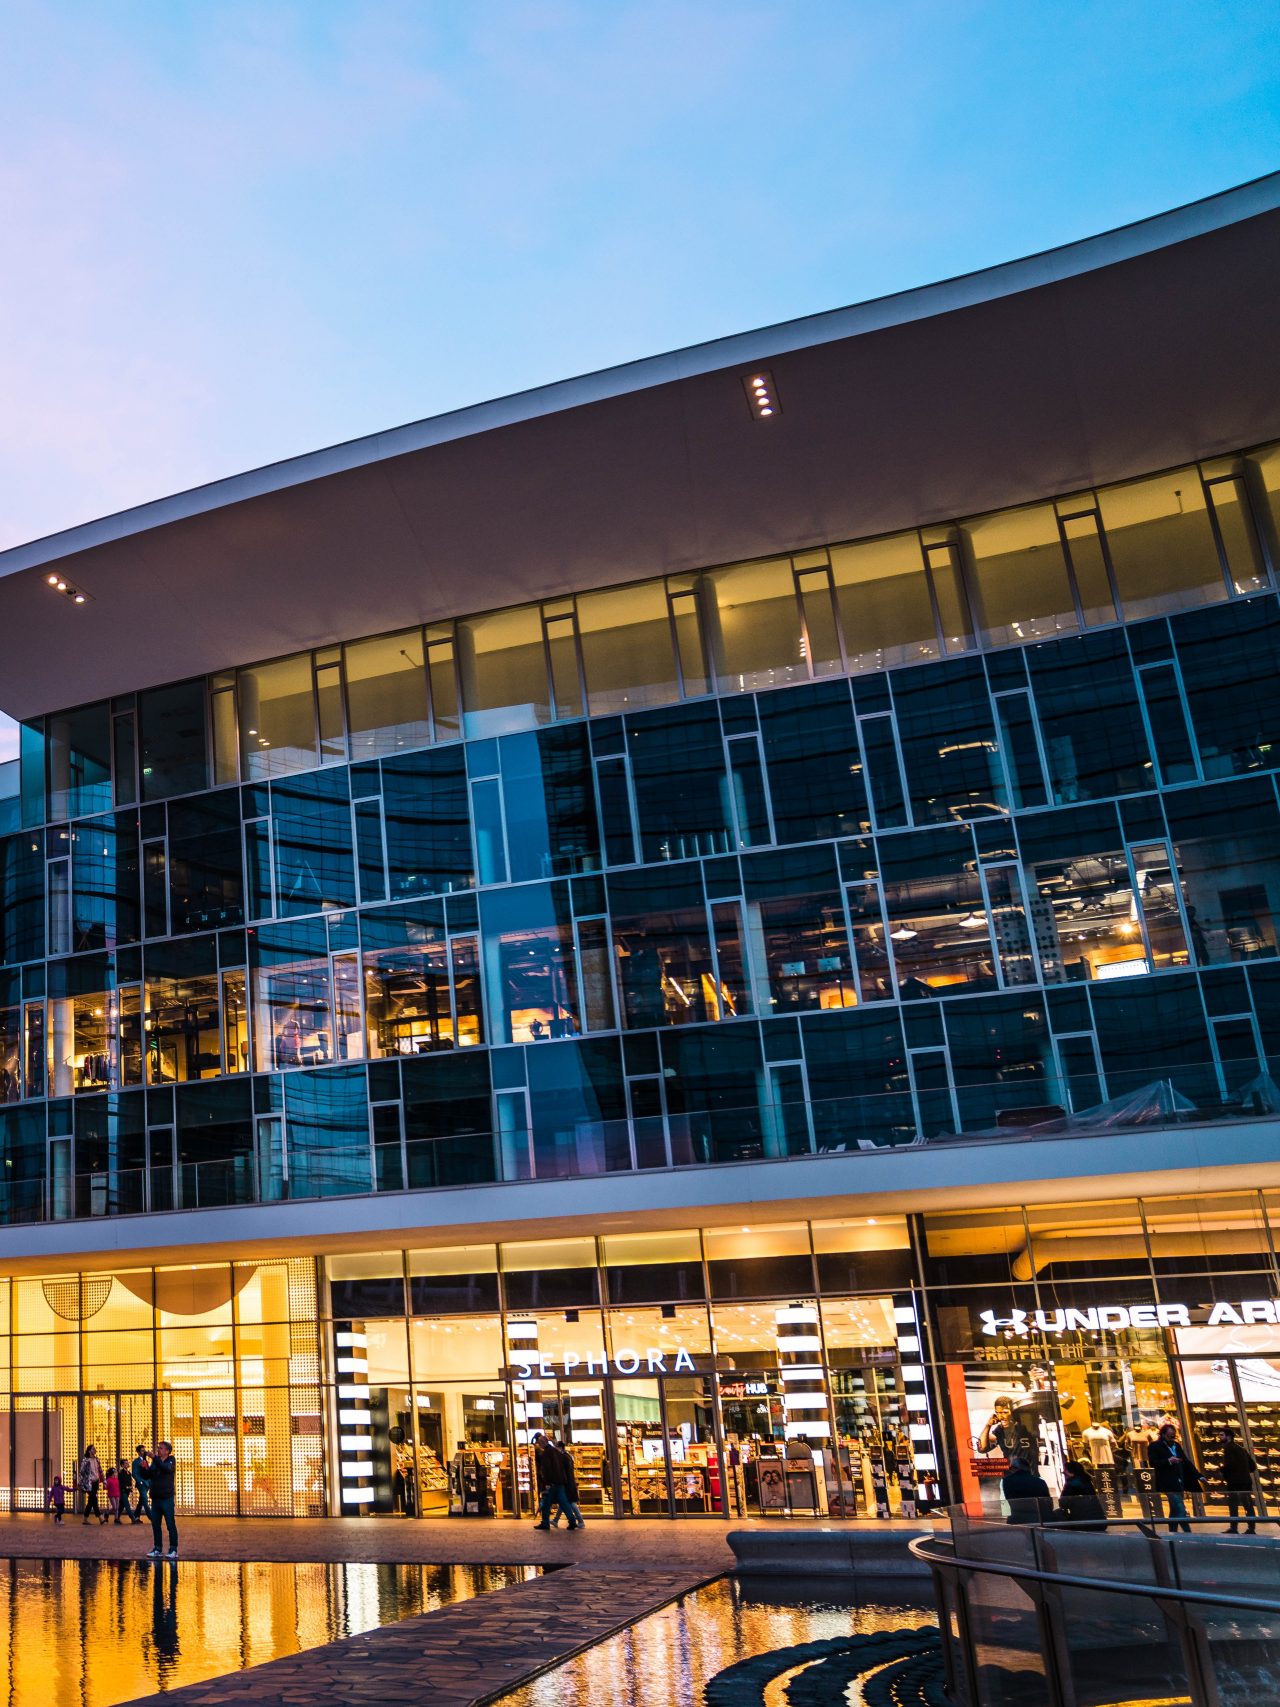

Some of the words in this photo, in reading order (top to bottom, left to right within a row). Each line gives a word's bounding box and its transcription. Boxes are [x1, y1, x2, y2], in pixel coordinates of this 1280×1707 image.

[1035, 1303, 1190, 1332] UNDER
[514, 1347, 696, 1378] SEPHORA
[745, 1383, 768, 1394] HUB
